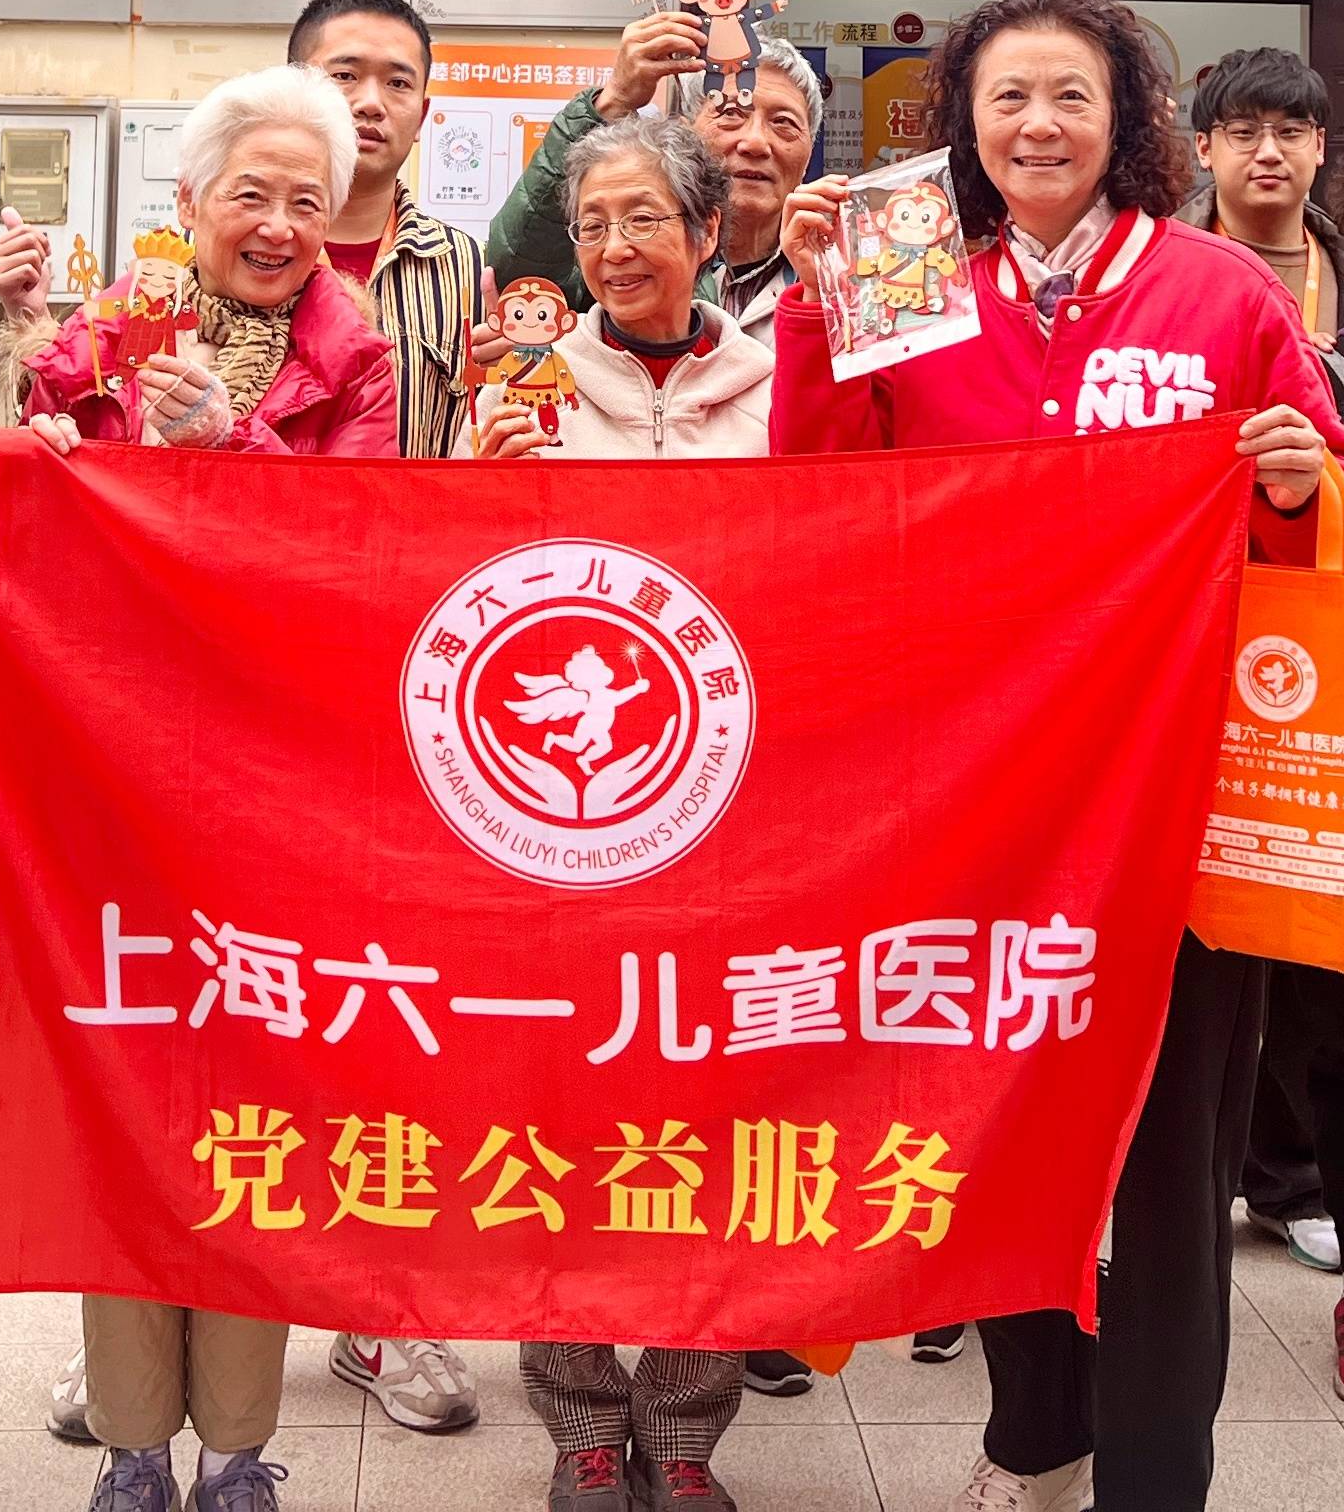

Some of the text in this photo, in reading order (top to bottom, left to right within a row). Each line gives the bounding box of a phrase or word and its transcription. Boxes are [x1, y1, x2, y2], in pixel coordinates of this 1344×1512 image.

[842, 23, 878, 41] 流程
[1075, 381, 1215, 429] NUT
[1082, 346, 1217, 394] DEVIL
[413, 557, 740, 714] 上海六一儿童医院
[434, 742, 730, 870] SHANGHAI LIUYI CHILDREN'S HOSPITAL
[62, 901, 1097, 1066] 上海六一儿童医院
[190, 1103, 971, 1254] 党建公益服务
